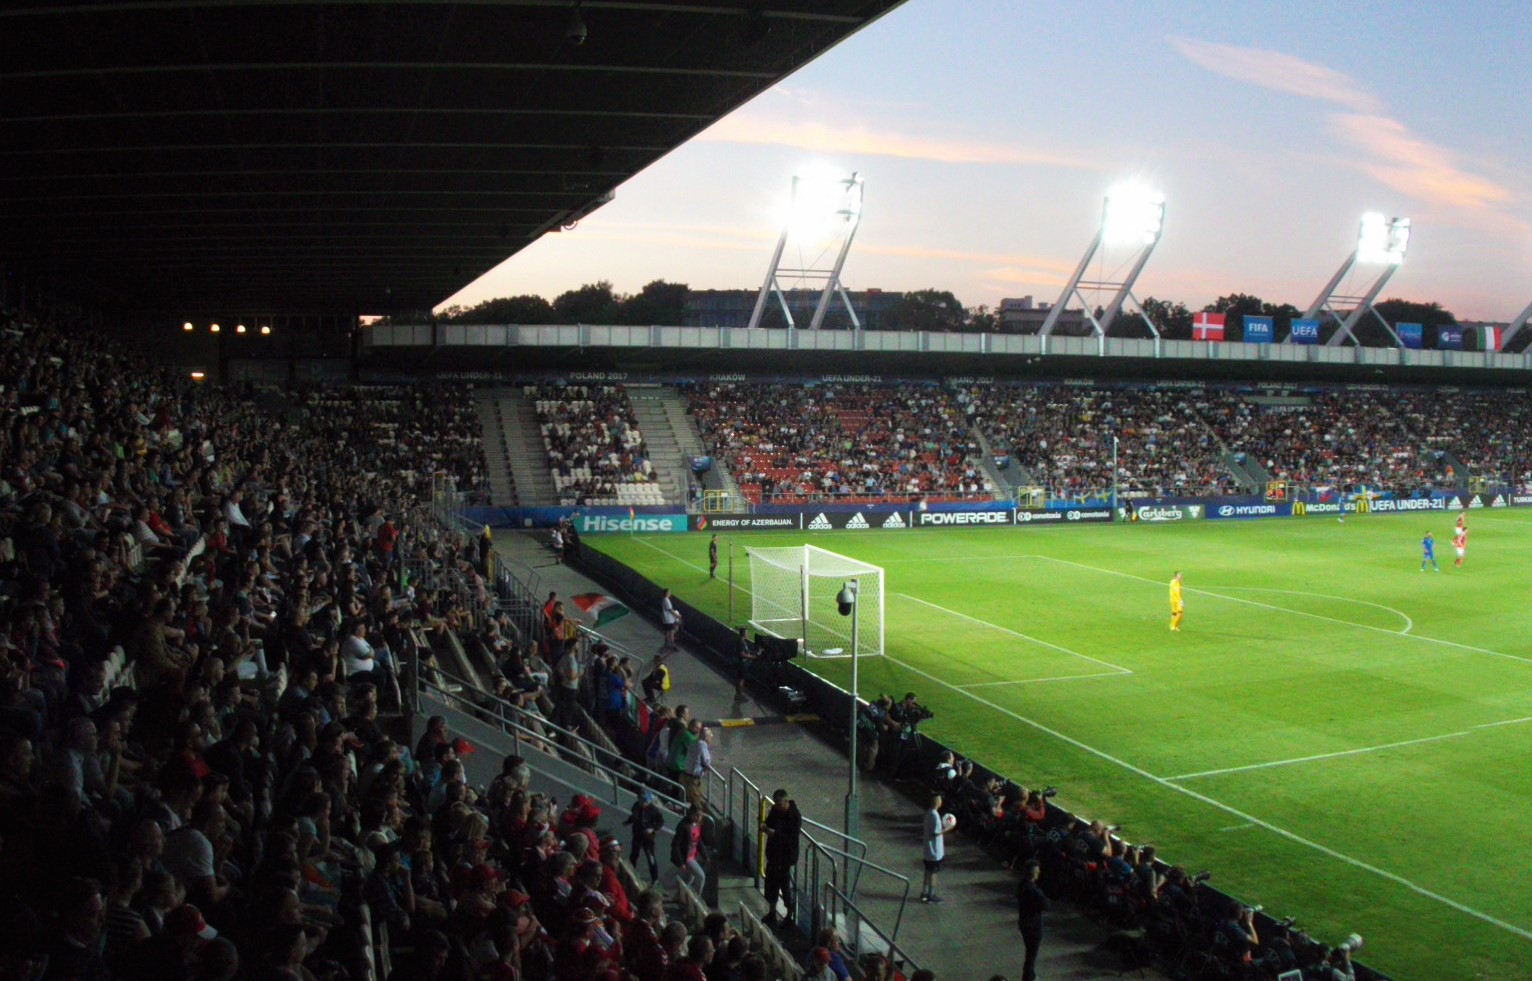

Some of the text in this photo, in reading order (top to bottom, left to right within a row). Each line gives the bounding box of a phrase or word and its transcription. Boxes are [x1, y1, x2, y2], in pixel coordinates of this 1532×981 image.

[1248, 323, 1269, 333] FIFA
[1292, 326, 1318, 336] UEFA
[570, 372, 606, 380] POLAND
[822, 375, 882, 383] UEFA UNDER-21
[1371, 499, 1444, 511] UEFA UNDER-21
[1138, 505, 1182, 520] Carlsberg
[1236, 506, 1276, 514] HYUNDAI
[921, 512, 1010, 524] POWERADE
[583, 516, 672, 532] Hisense
[712, 519, 740, 527] ENERGY
[742, 519, 752, 527] OF
[808, 522, 833, 530] adidas
[883, 521, 906, 529] adidas
